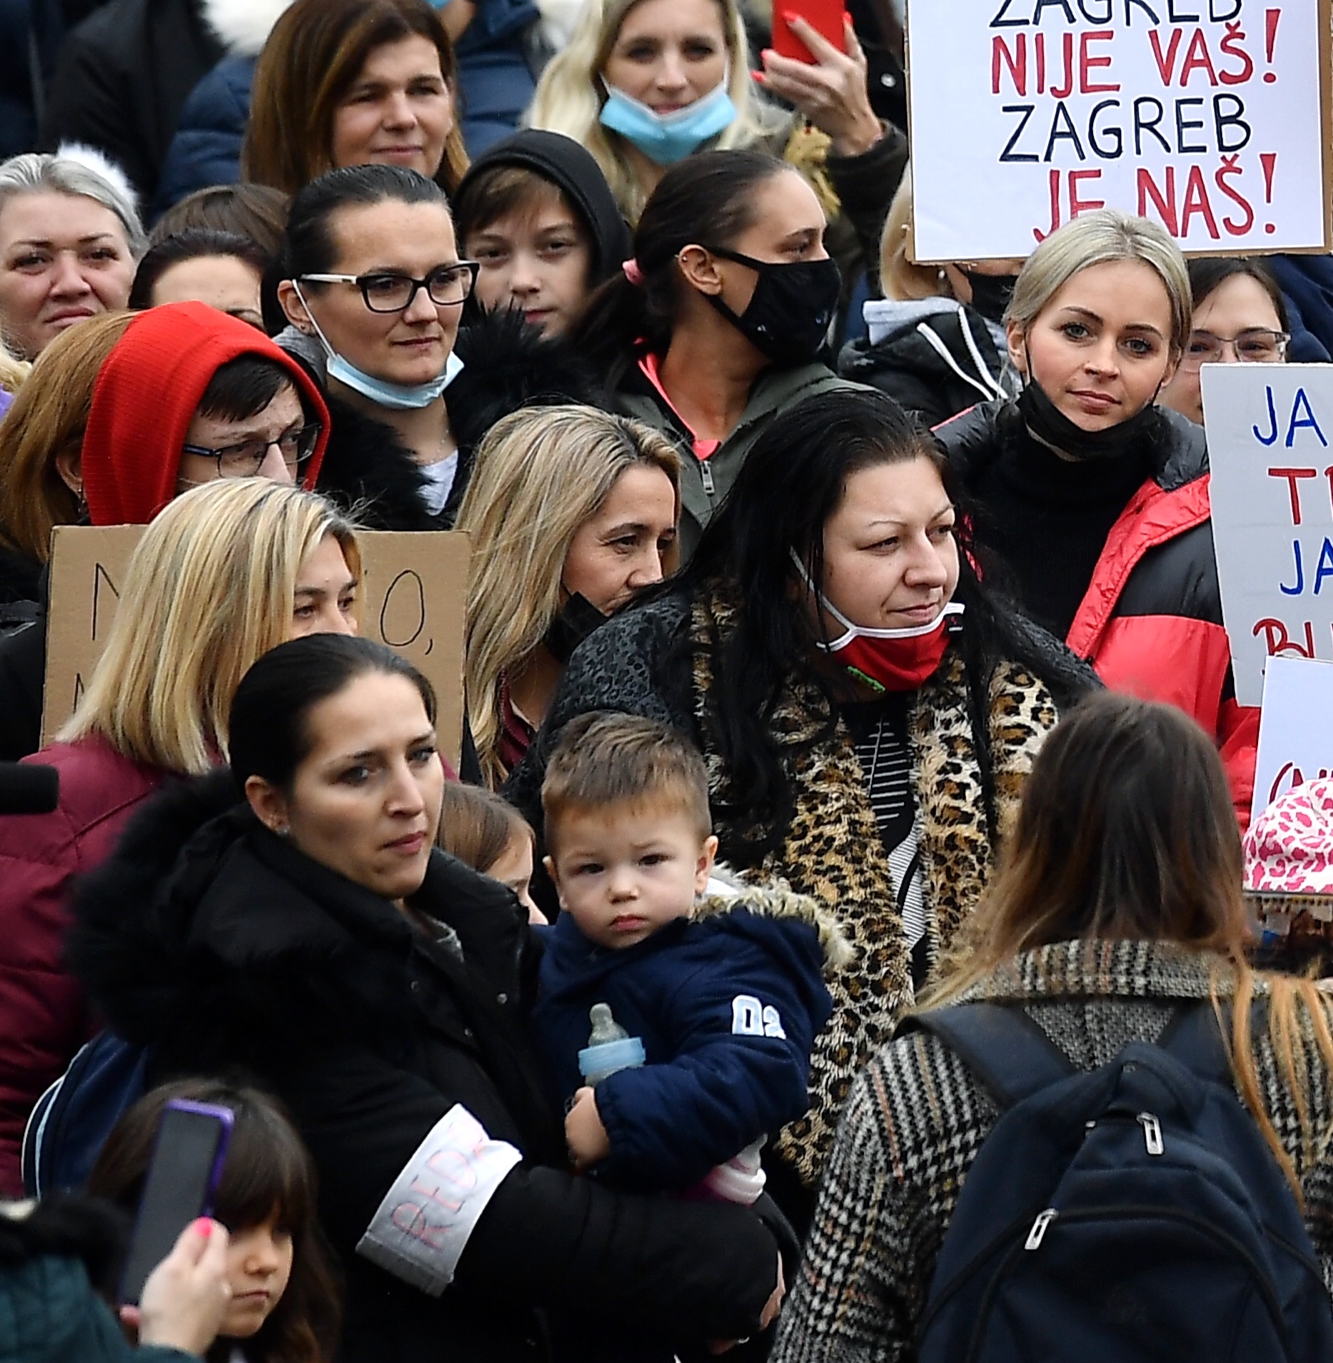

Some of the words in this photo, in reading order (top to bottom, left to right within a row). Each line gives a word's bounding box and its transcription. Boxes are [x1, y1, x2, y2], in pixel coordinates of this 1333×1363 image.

[991, 29, 1121, 98] NIJE
[1148, 9, 1281, 86] VAŠ!
[999, 93, 1251, 162] ZAGREB
[1033, 169, 1105, 243] JE
[1137, 153, 1277, 239] NAŠ!
[1252, 385, 1328, 447] JA
